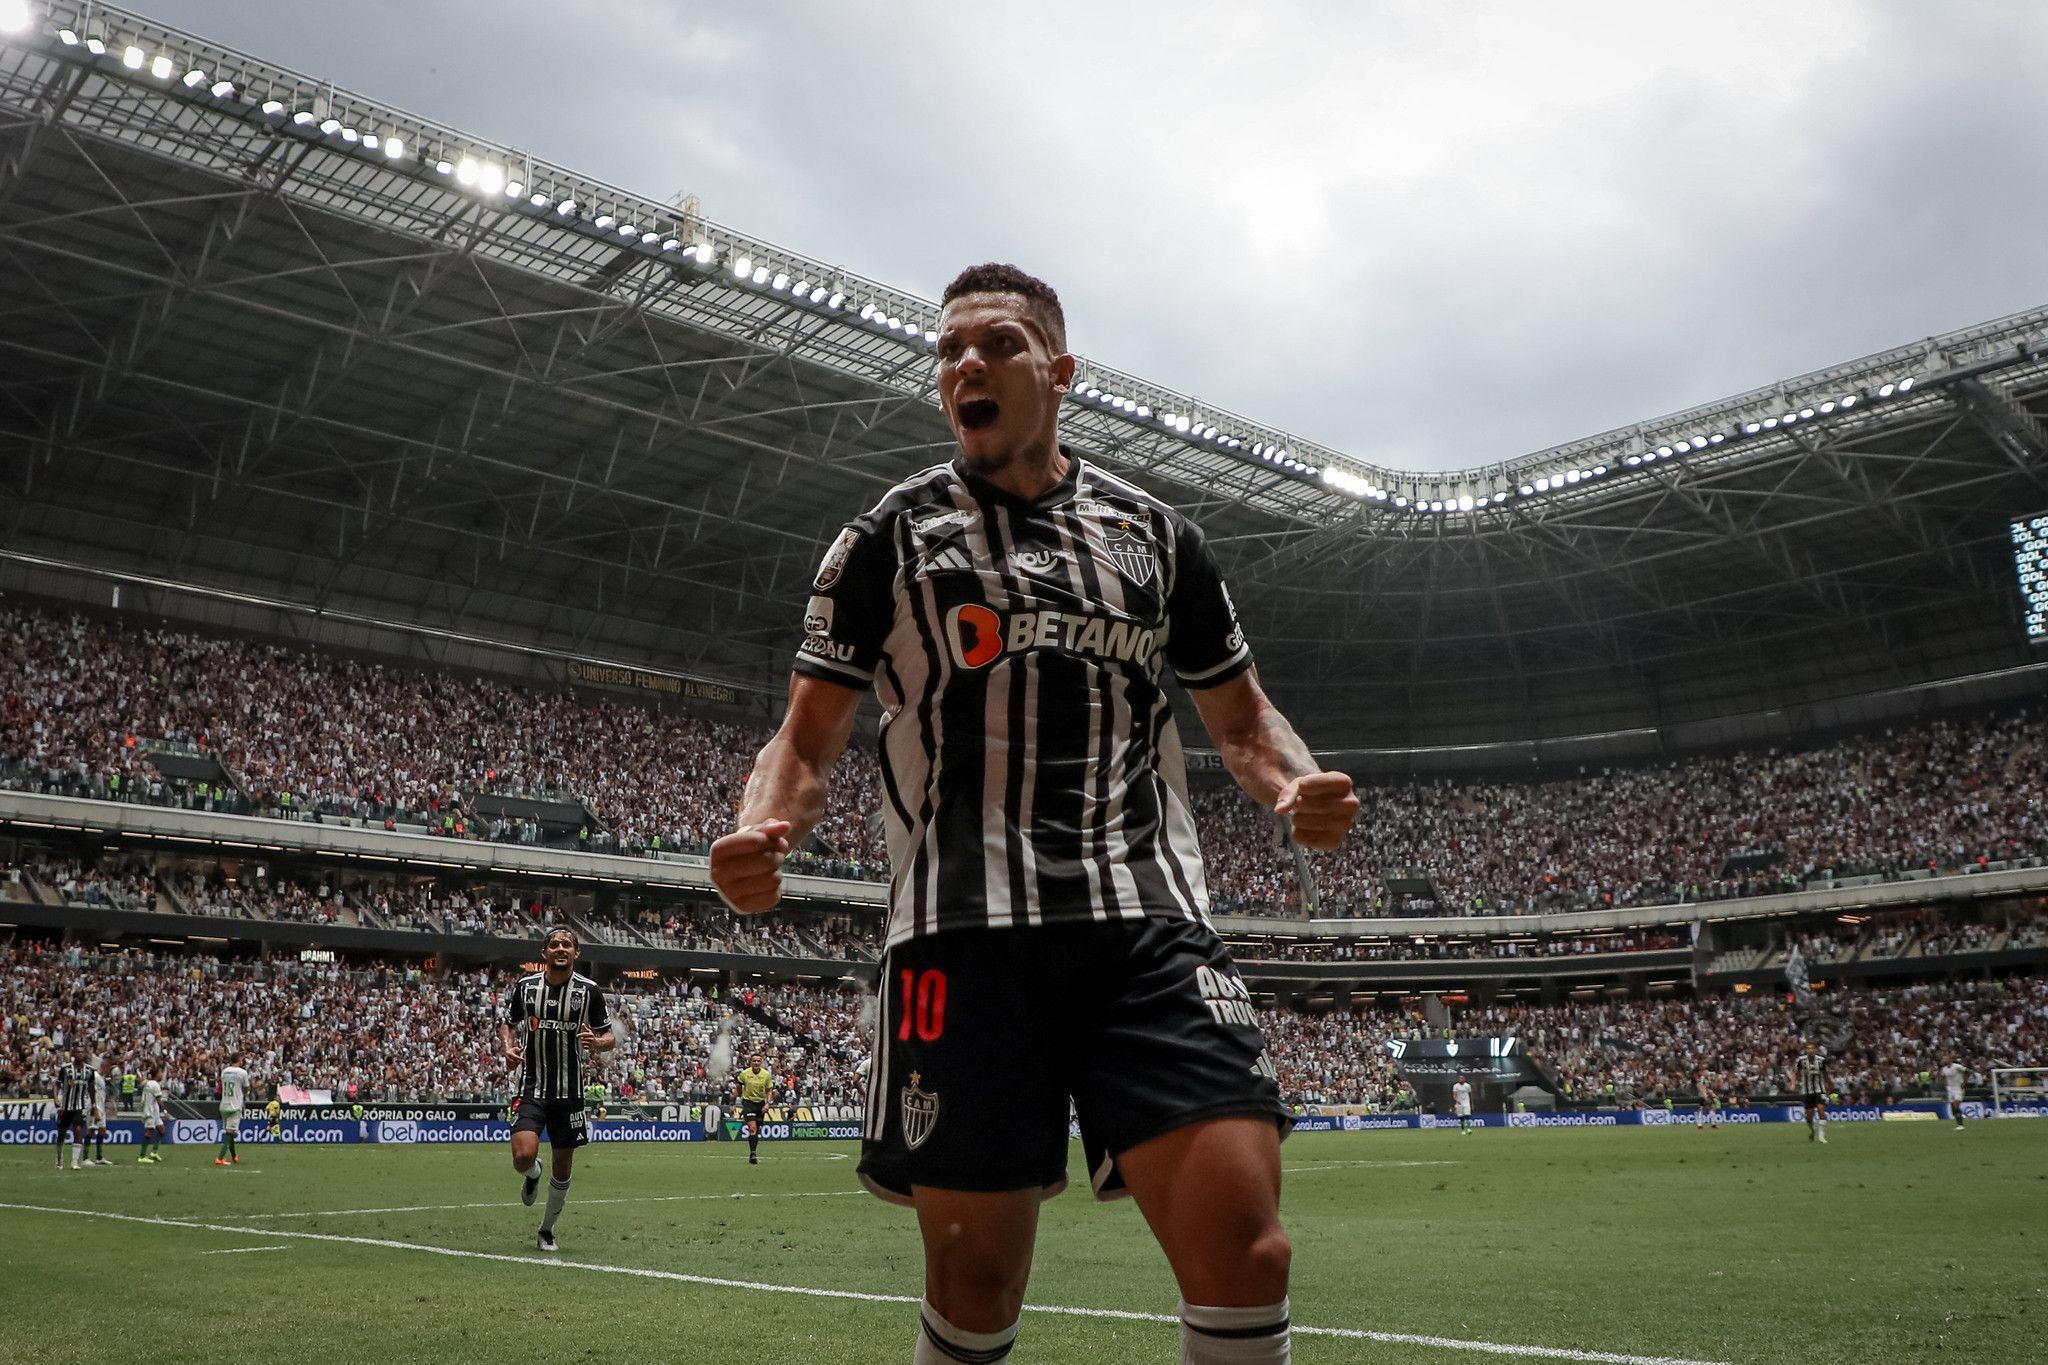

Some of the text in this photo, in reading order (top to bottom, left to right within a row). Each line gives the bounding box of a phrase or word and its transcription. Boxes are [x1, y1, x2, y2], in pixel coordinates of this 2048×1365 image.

[1007, 610, 1154, 666] BETANO
[583, 665, 735, 703] UNIVERSO FEMININO ALVINEGRO
[898, 969, 947, 1041] 10
[538, 1019, 577, 1031] BETANO
[406, 1110, 423, 1120] DO
[427, 1110, 457, 1121] GALO
[792, 1127, 827, 1138] MINEIRO
